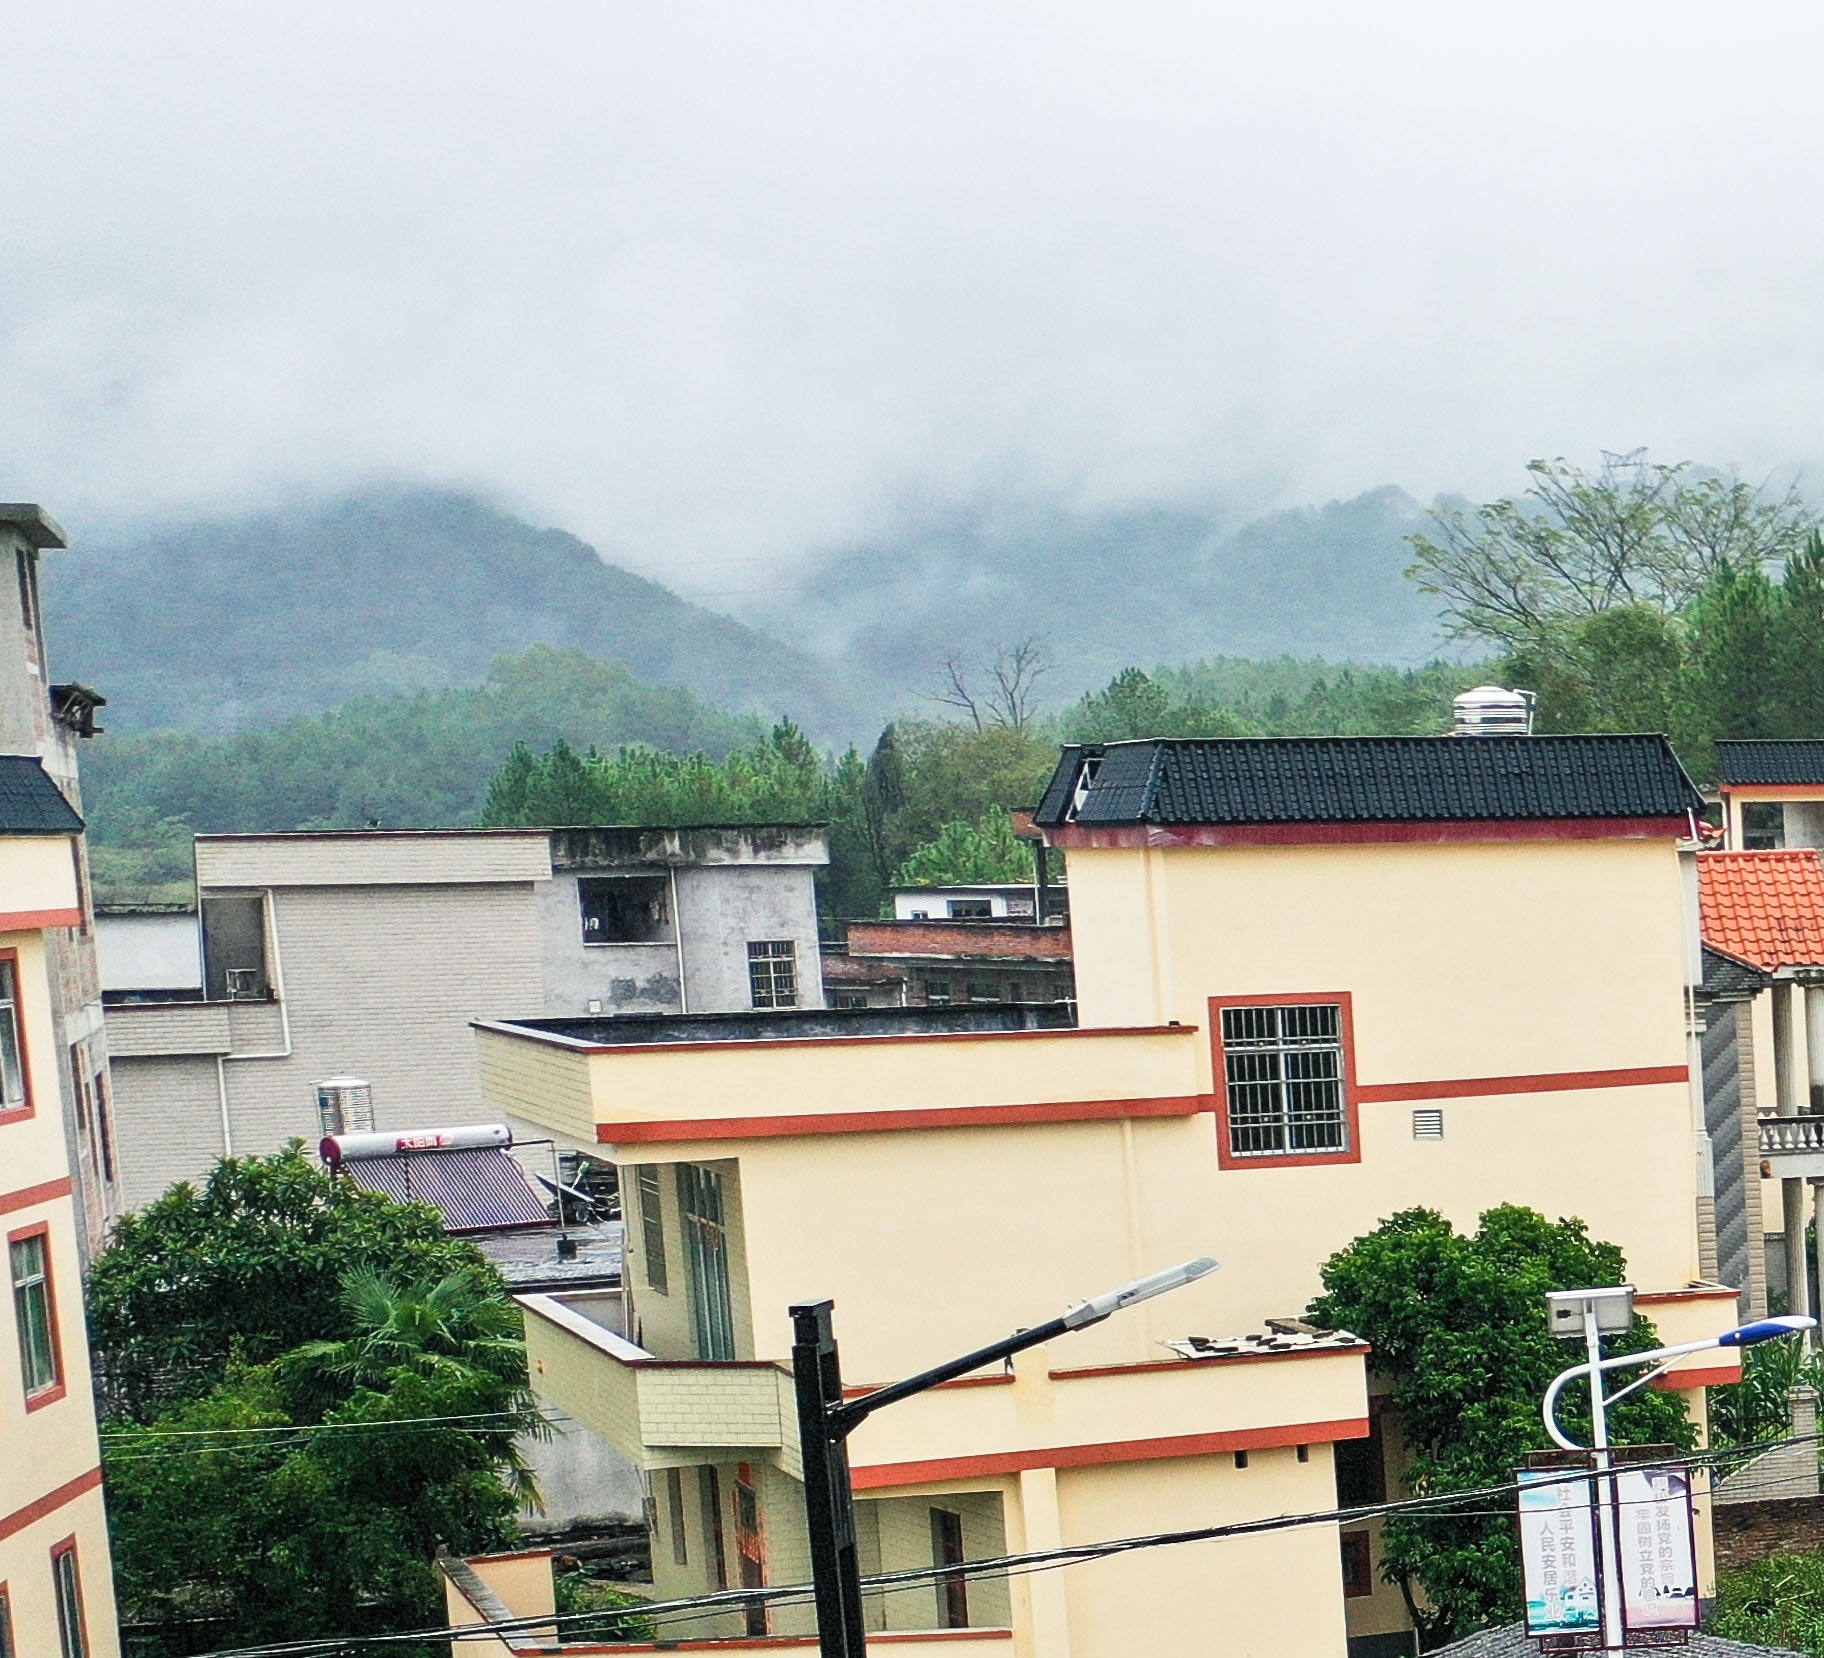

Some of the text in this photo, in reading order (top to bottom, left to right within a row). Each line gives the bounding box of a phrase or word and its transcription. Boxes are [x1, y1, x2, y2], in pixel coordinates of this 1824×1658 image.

[1540, 1520, 1563, 1620] 人民安居乐业
[1556, 1485, 1579, 1587] 社会平安和谐
